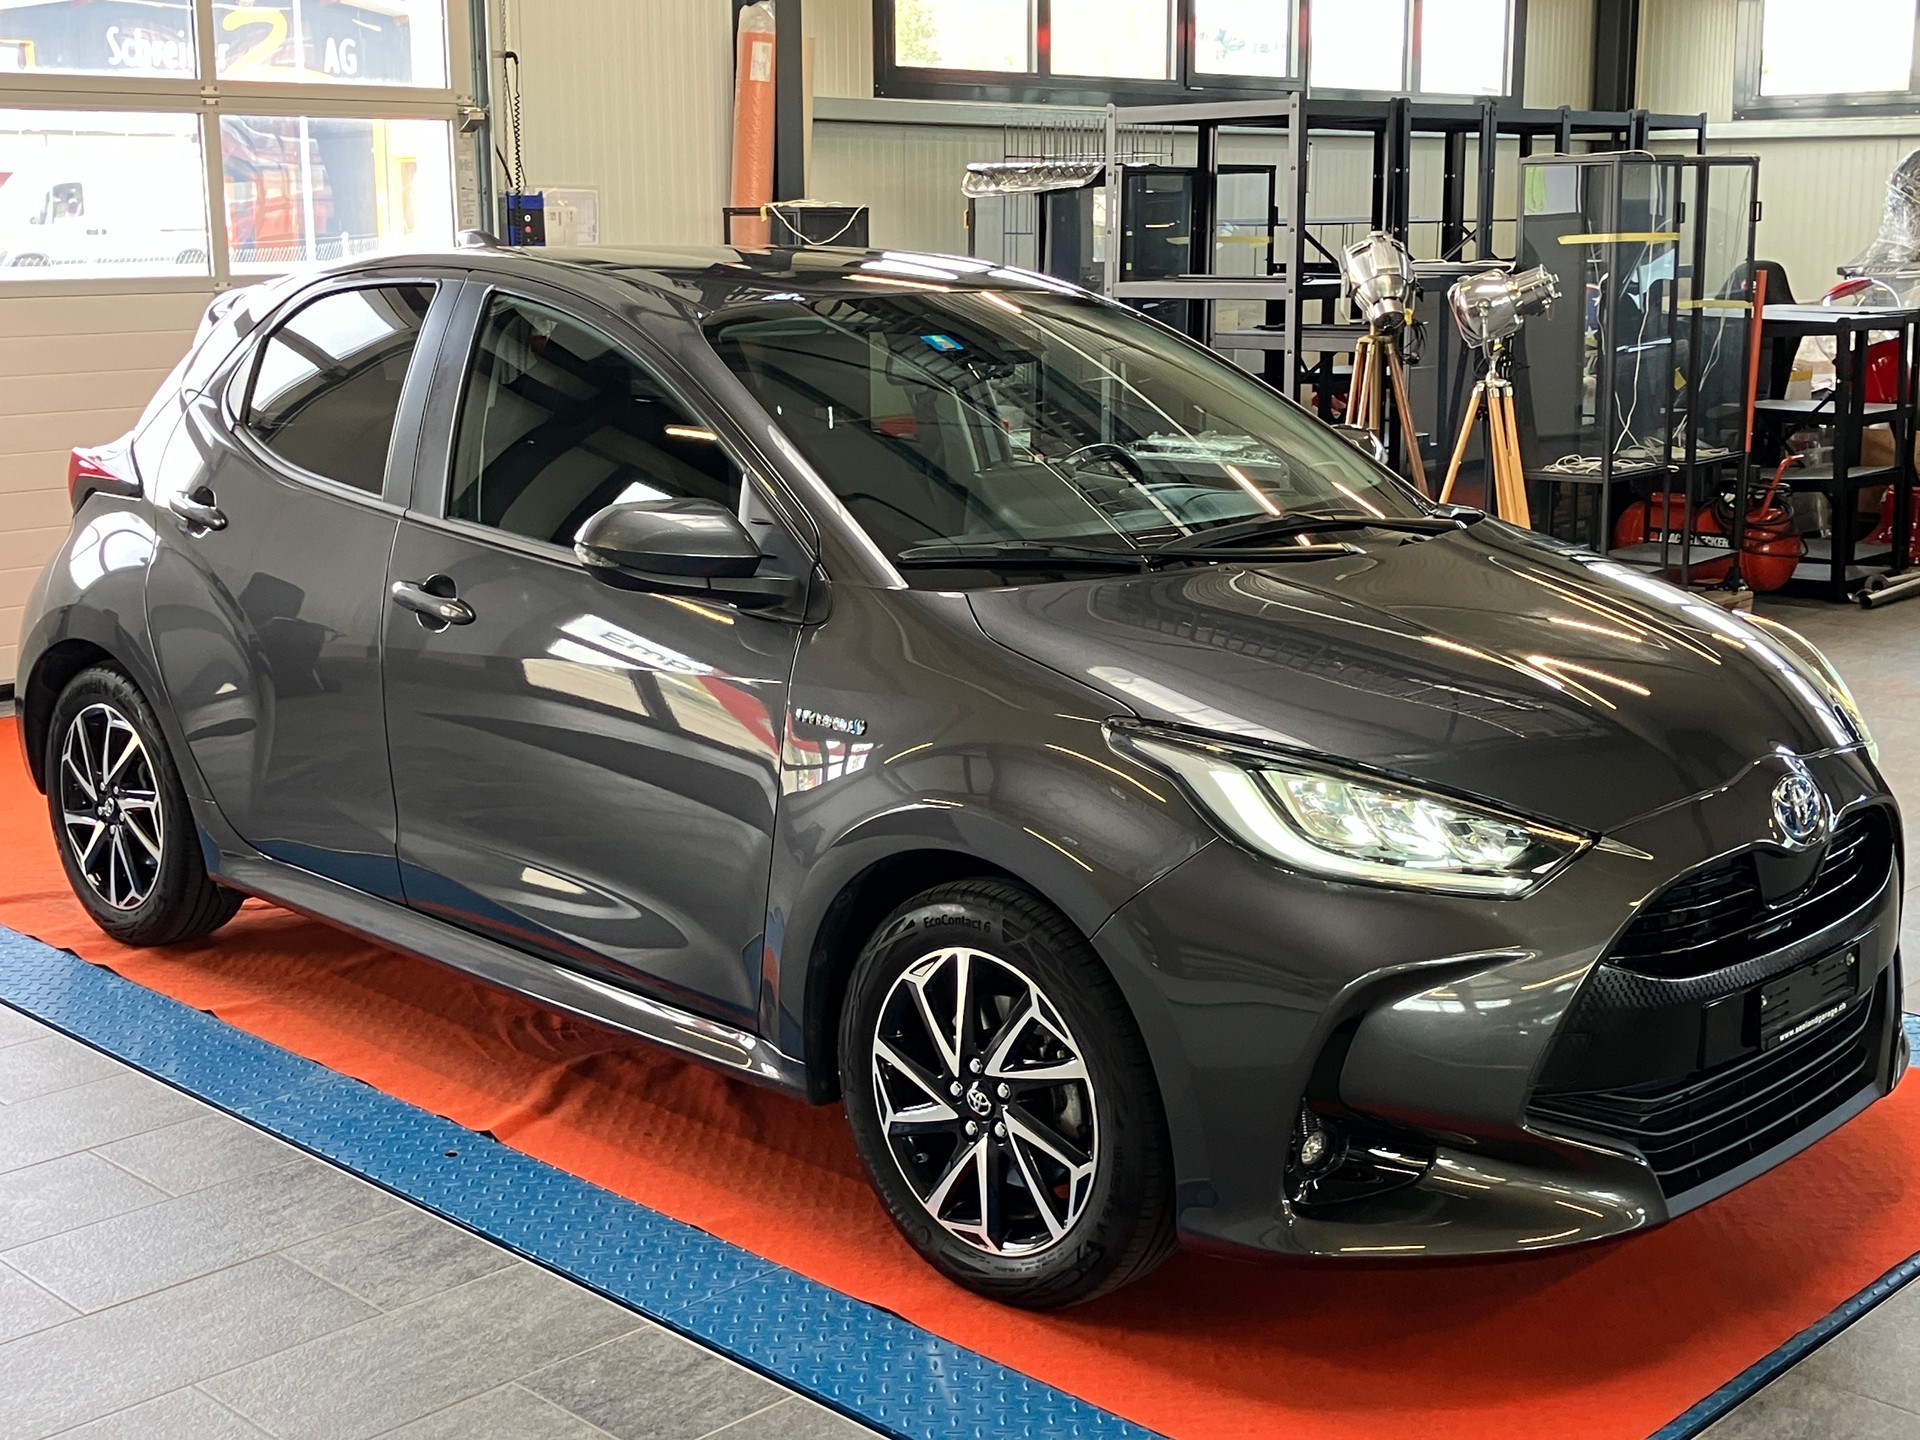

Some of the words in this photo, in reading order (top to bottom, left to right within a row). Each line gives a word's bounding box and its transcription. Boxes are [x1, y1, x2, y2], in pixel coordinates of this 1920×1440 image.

[106, 26, 230, 71] Schreir
[324, 37, 358, 74] AG
[923, 914, 981, 930] EcoContact
[983, 921, 991, 933] 6
